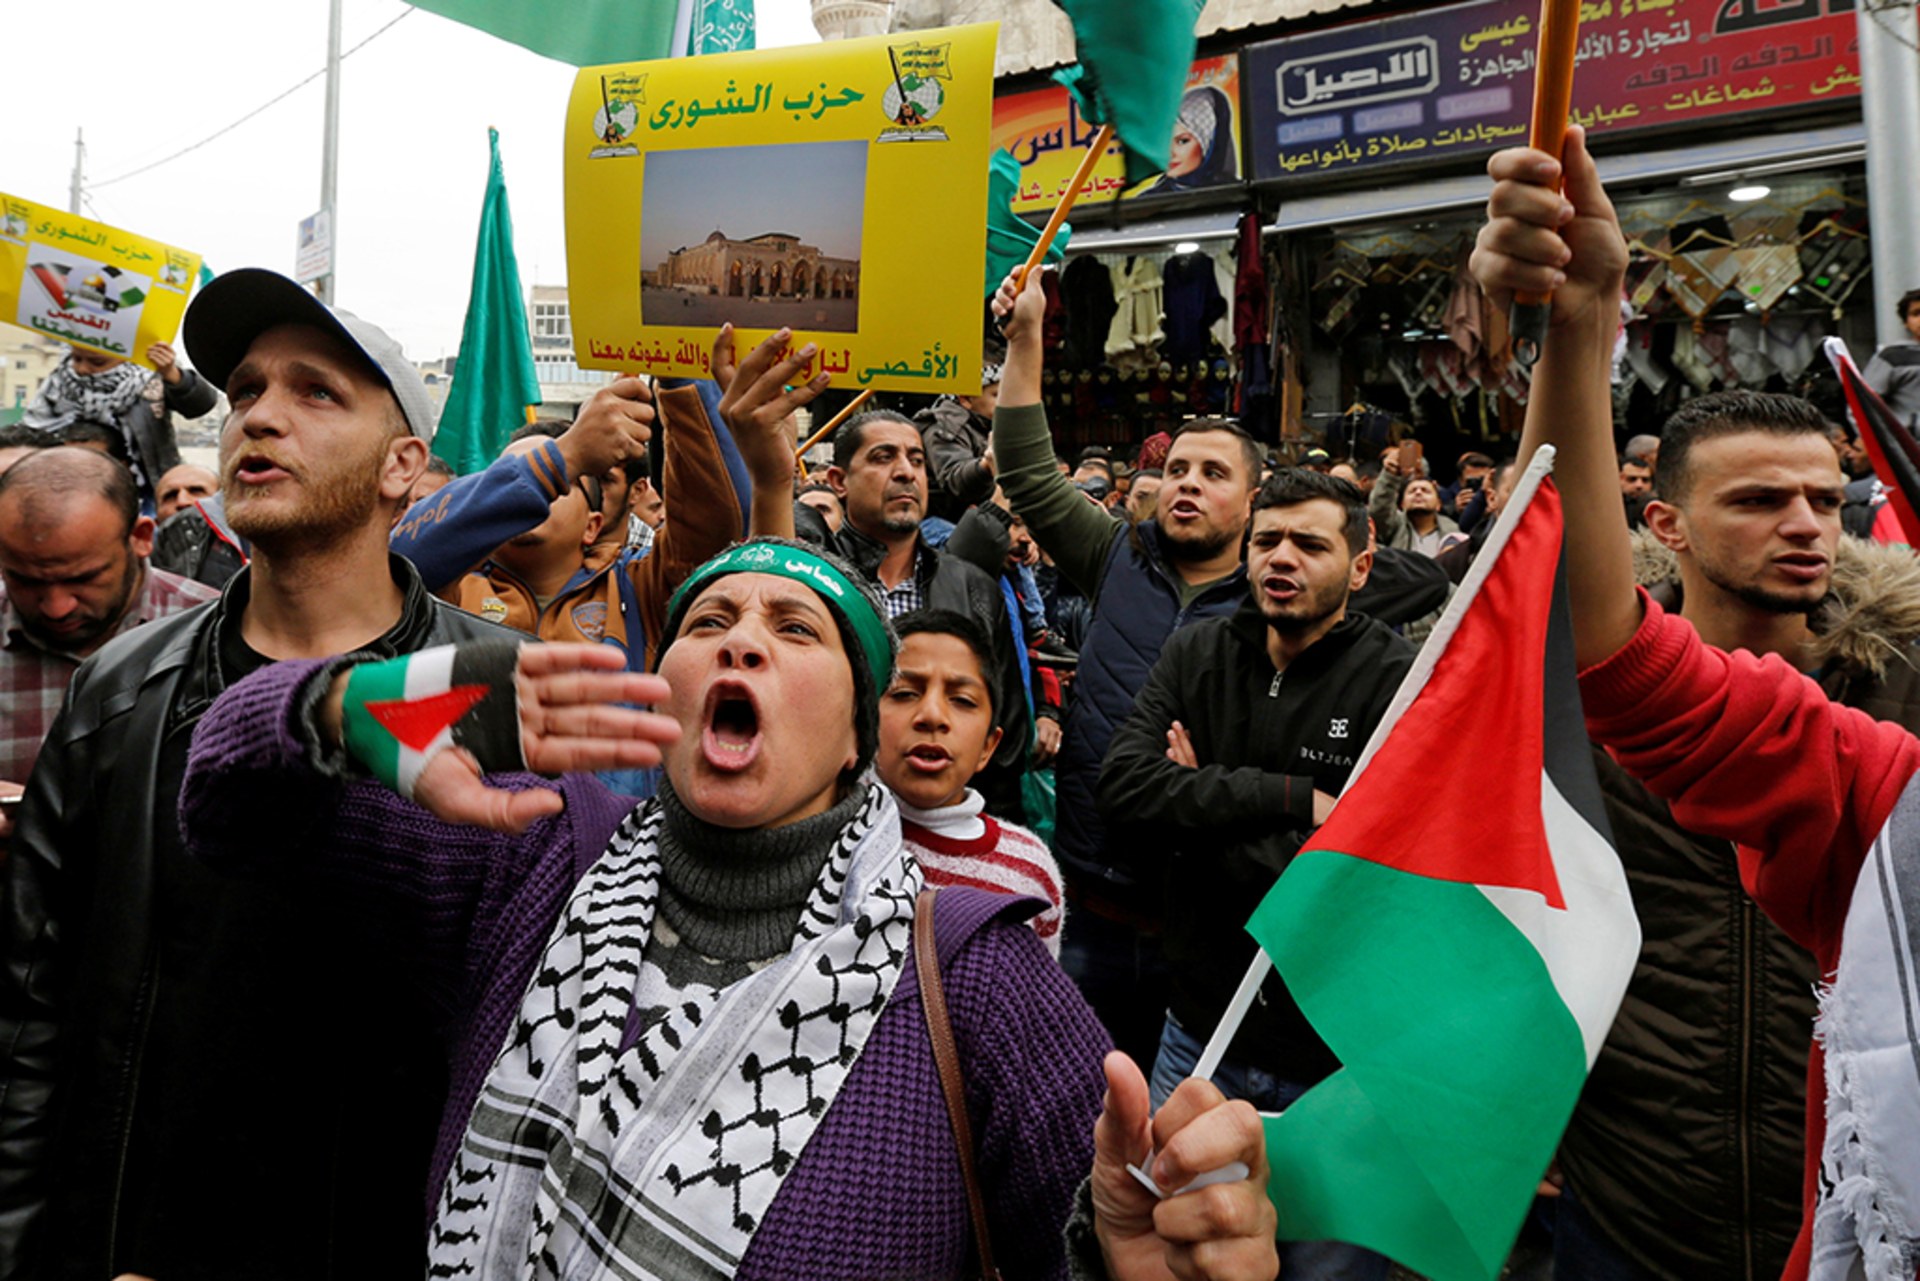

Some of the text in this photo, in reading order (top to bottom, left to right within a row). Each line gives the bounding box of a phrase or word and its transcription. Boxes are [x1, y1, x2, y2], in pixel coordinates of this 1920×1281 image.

[1459, 14, 1531, 53] عيسى
[1618, 19, 1691, 58] لتجارة
[1459, 48, 1535, 86] الجاهزة
[649, 79, 865, 131] حزب الشورى
[1664, 76, 1776, 111] شماغات
[1278, 122, 1527, 172] سجادات صلاة بأنواعها
[35, 221, 108, 247] الشورى
[111, 244, 154, 261] حزب
[31, 315, 128, 354] عاصمتنا
[47, 307, 112, 332] القدس
[589, 338, 625, 361] معنا
[820, 348, 850, 373] لنا
[857, 342, 959, 385] الأقصى
[785, 559, 844, 597] حماس
